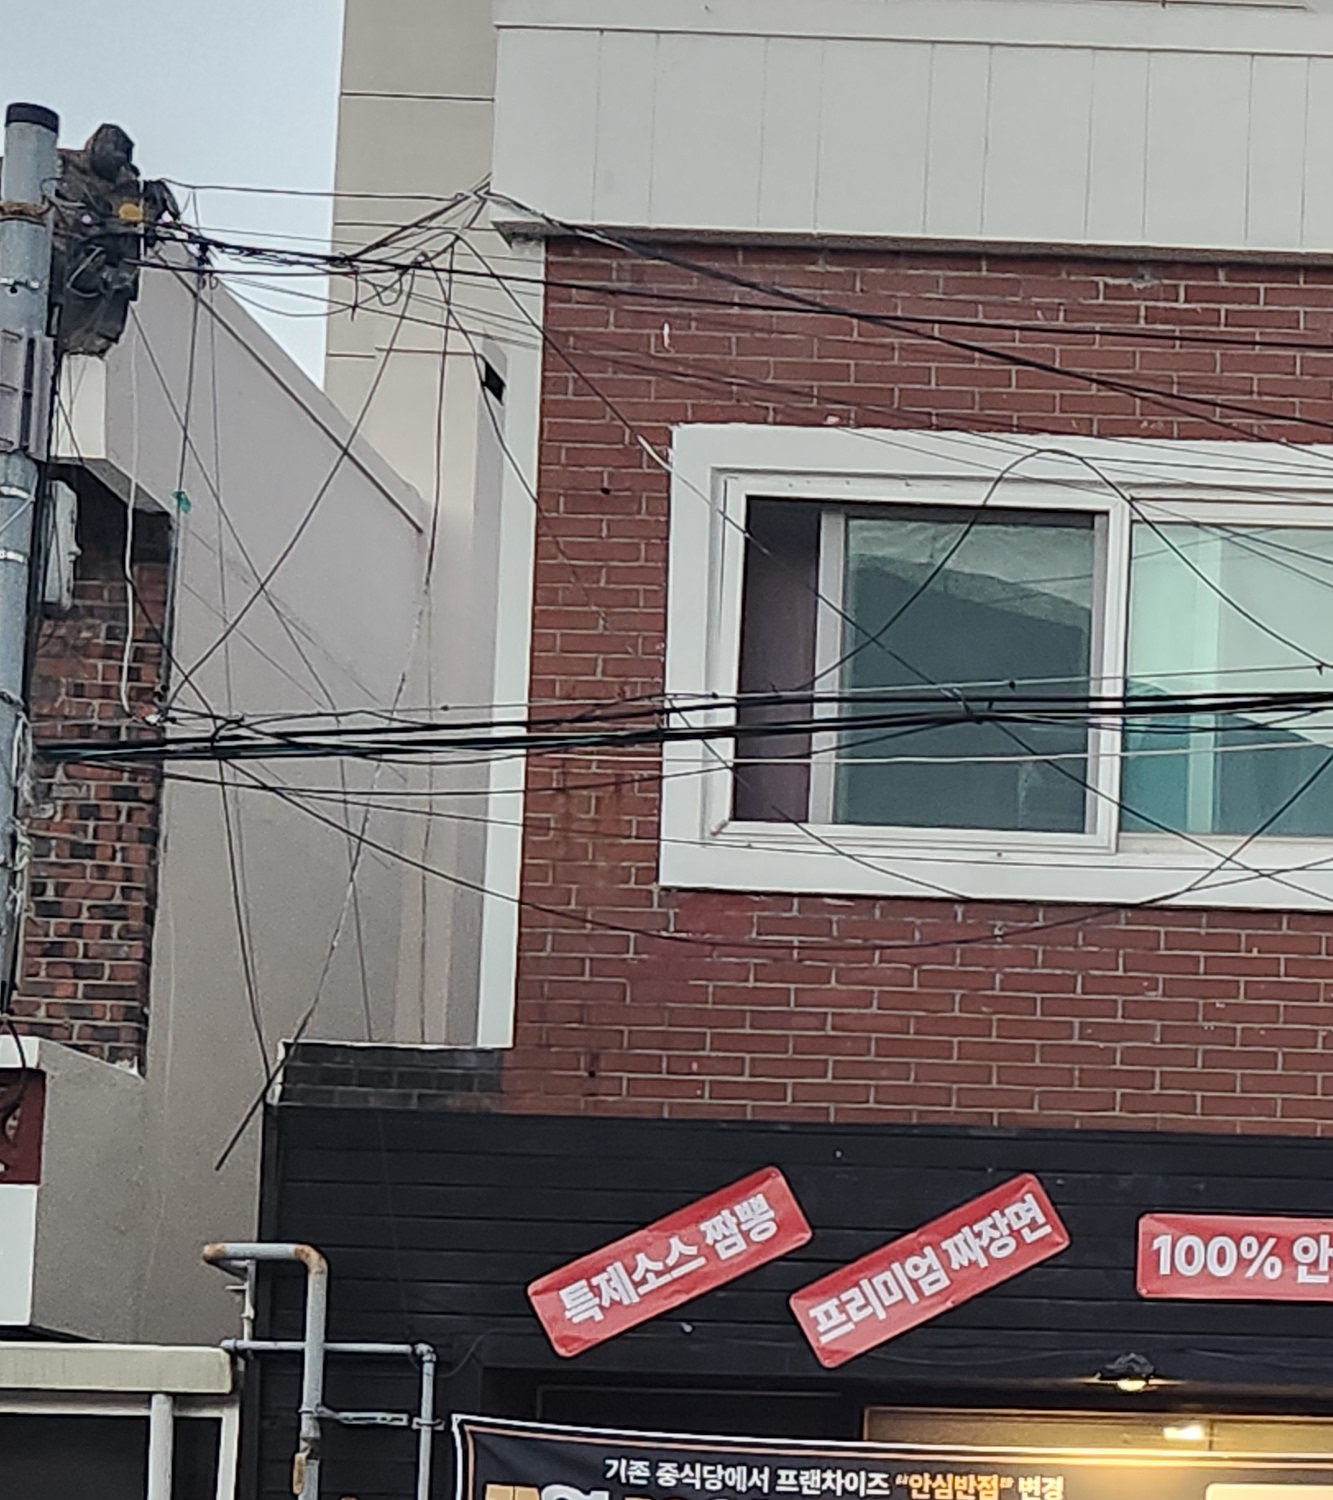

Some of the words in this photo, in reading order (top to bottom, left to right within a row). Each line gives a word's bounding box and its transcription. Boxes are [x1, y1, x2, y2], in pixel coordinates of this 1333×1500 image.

[560, 1239, 706, 1323] 특제소스
[704, 1195, 778, 1259] 짬뽕
[808, 1251, 951, 1343] 프리미엄
[941, 1195, 1053, 1270] 짜장면
[1152, 1234, 1283, 1280] 100%
[604, 1457, 650, 1485] 기존
[655, 1461, 771, 1492] 중식당에서
[775, 1467, 890, 1498] 프랜차이즈
